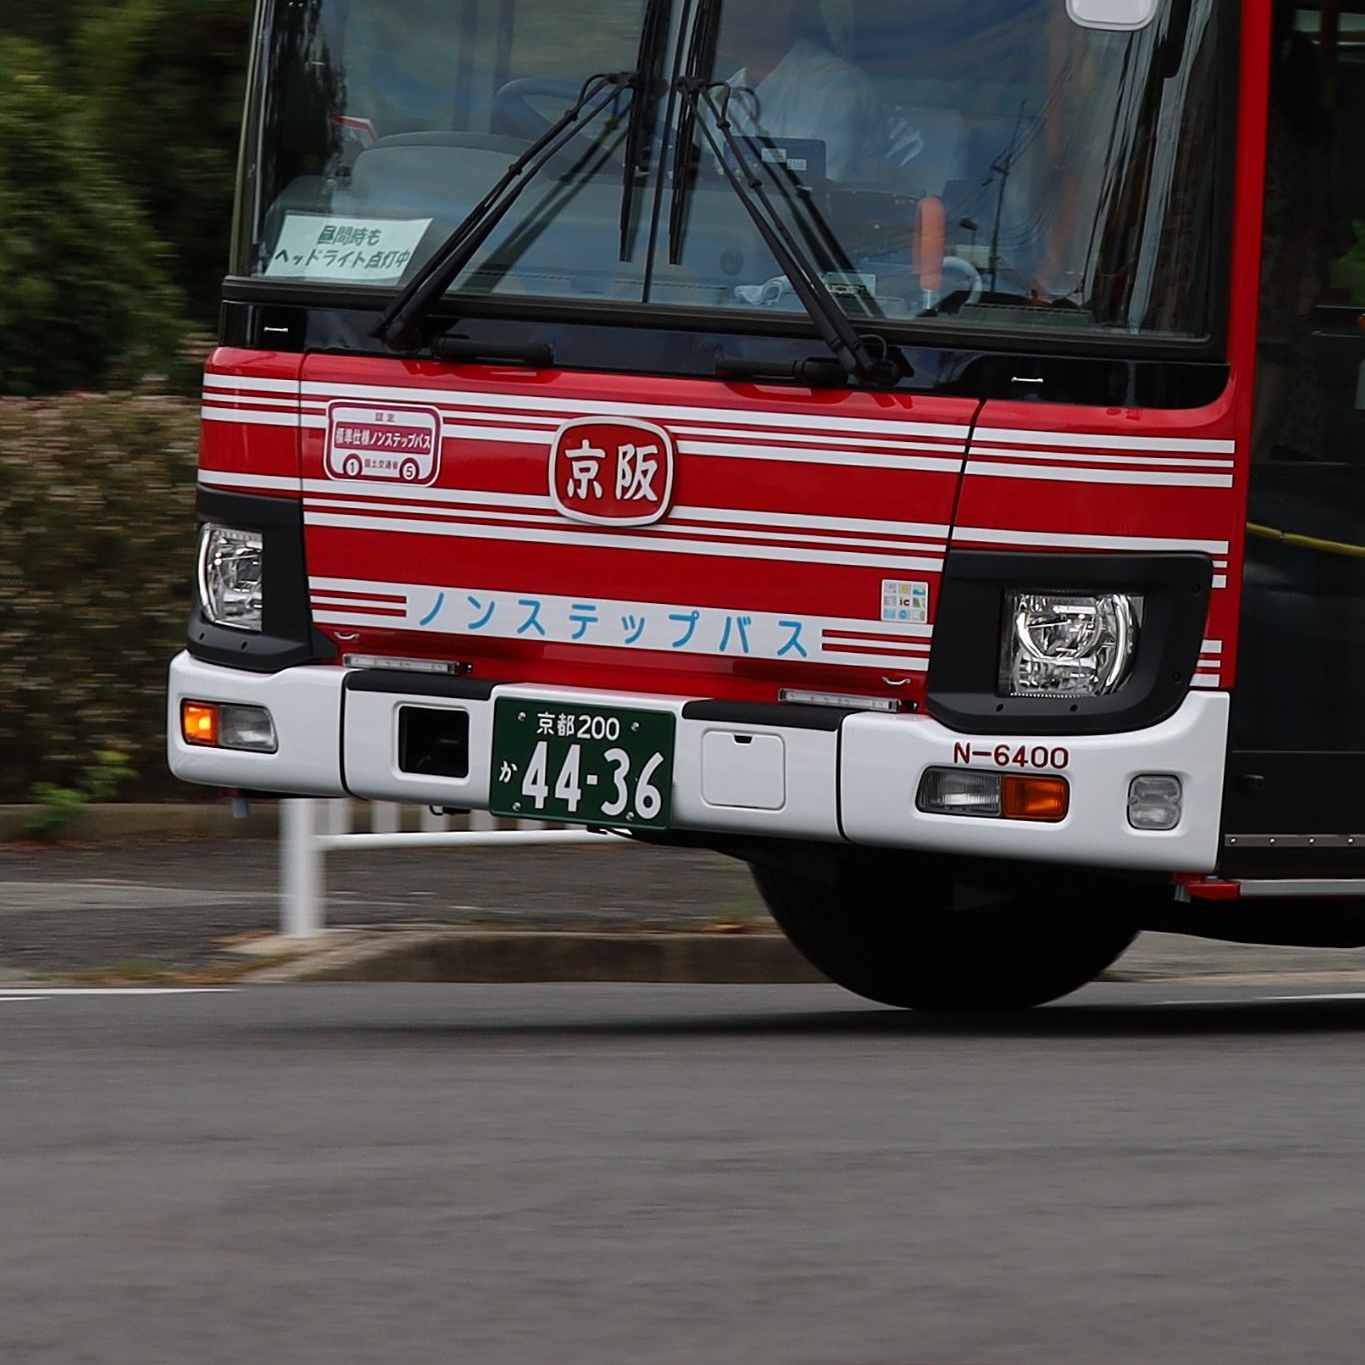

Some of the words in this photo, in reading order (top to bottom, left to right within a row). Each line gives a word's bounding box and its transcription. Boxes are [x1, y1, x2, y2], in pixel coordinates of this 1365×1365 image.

[317, 225, 381, 245] 昼間時も
[275, 248, 411, 269] ヘッドライト点灯中
[565, 440, 660, 502] 京阪
[420, 592, 808, 658] ノンステップバス
[954, 743, 1069, 770] N-6400
[499, 760, 518, 783] か
[522, 741, 664, 819] 44-36
